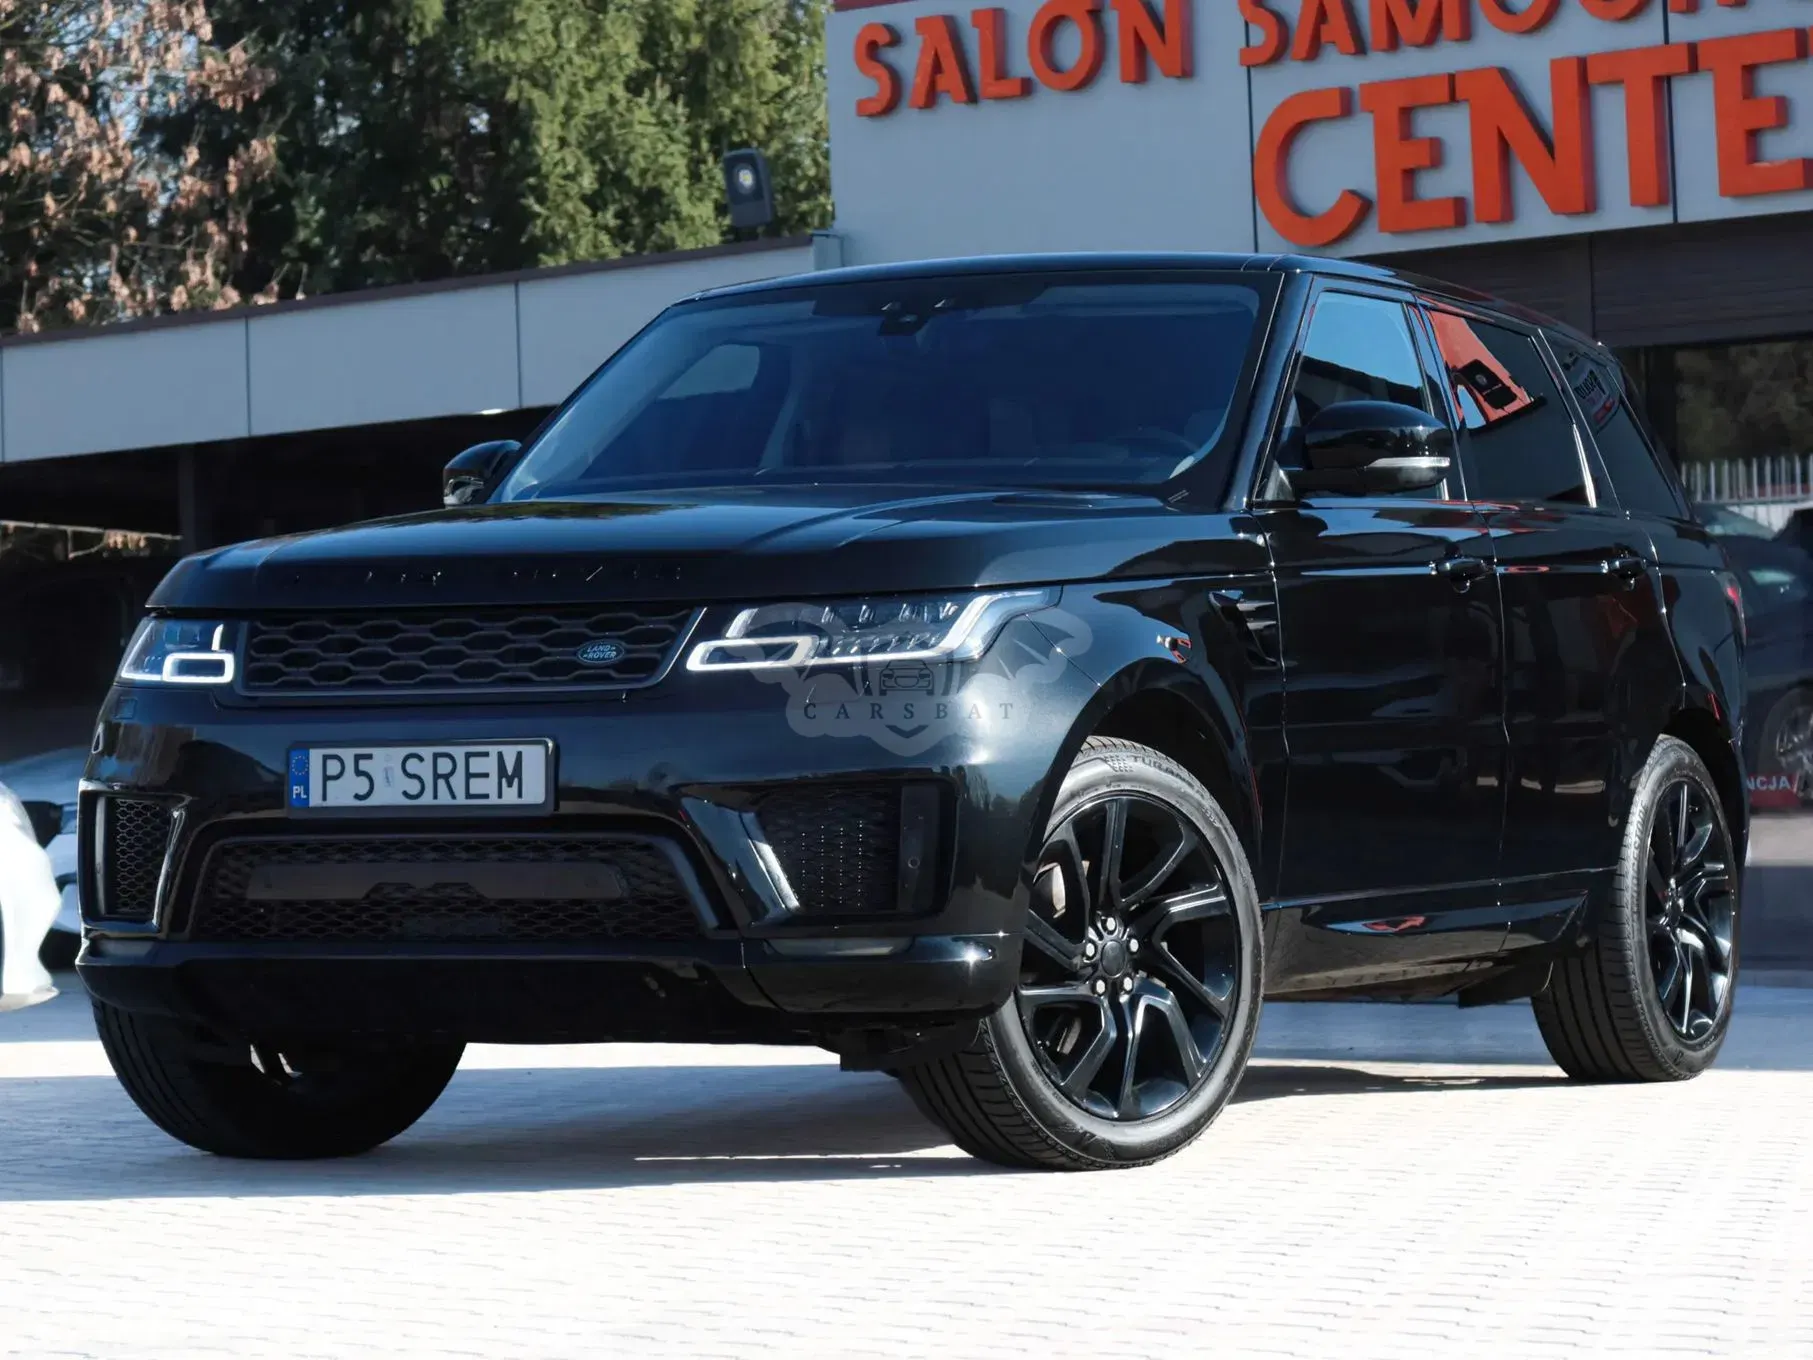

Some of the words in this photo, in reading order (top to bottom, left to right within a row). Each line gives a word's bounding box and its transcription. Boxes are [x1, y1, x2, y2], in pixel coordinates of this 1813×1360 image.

[854, 0, 1194, 118] SALON
[1238, 0, 1746, 67] SAM
[1253, 25, 1813, 247] CENTE
[292, 785, 308, 799] PL
[321, 753, 375, 802] P5
[401, 750, 523, 801] SREM
